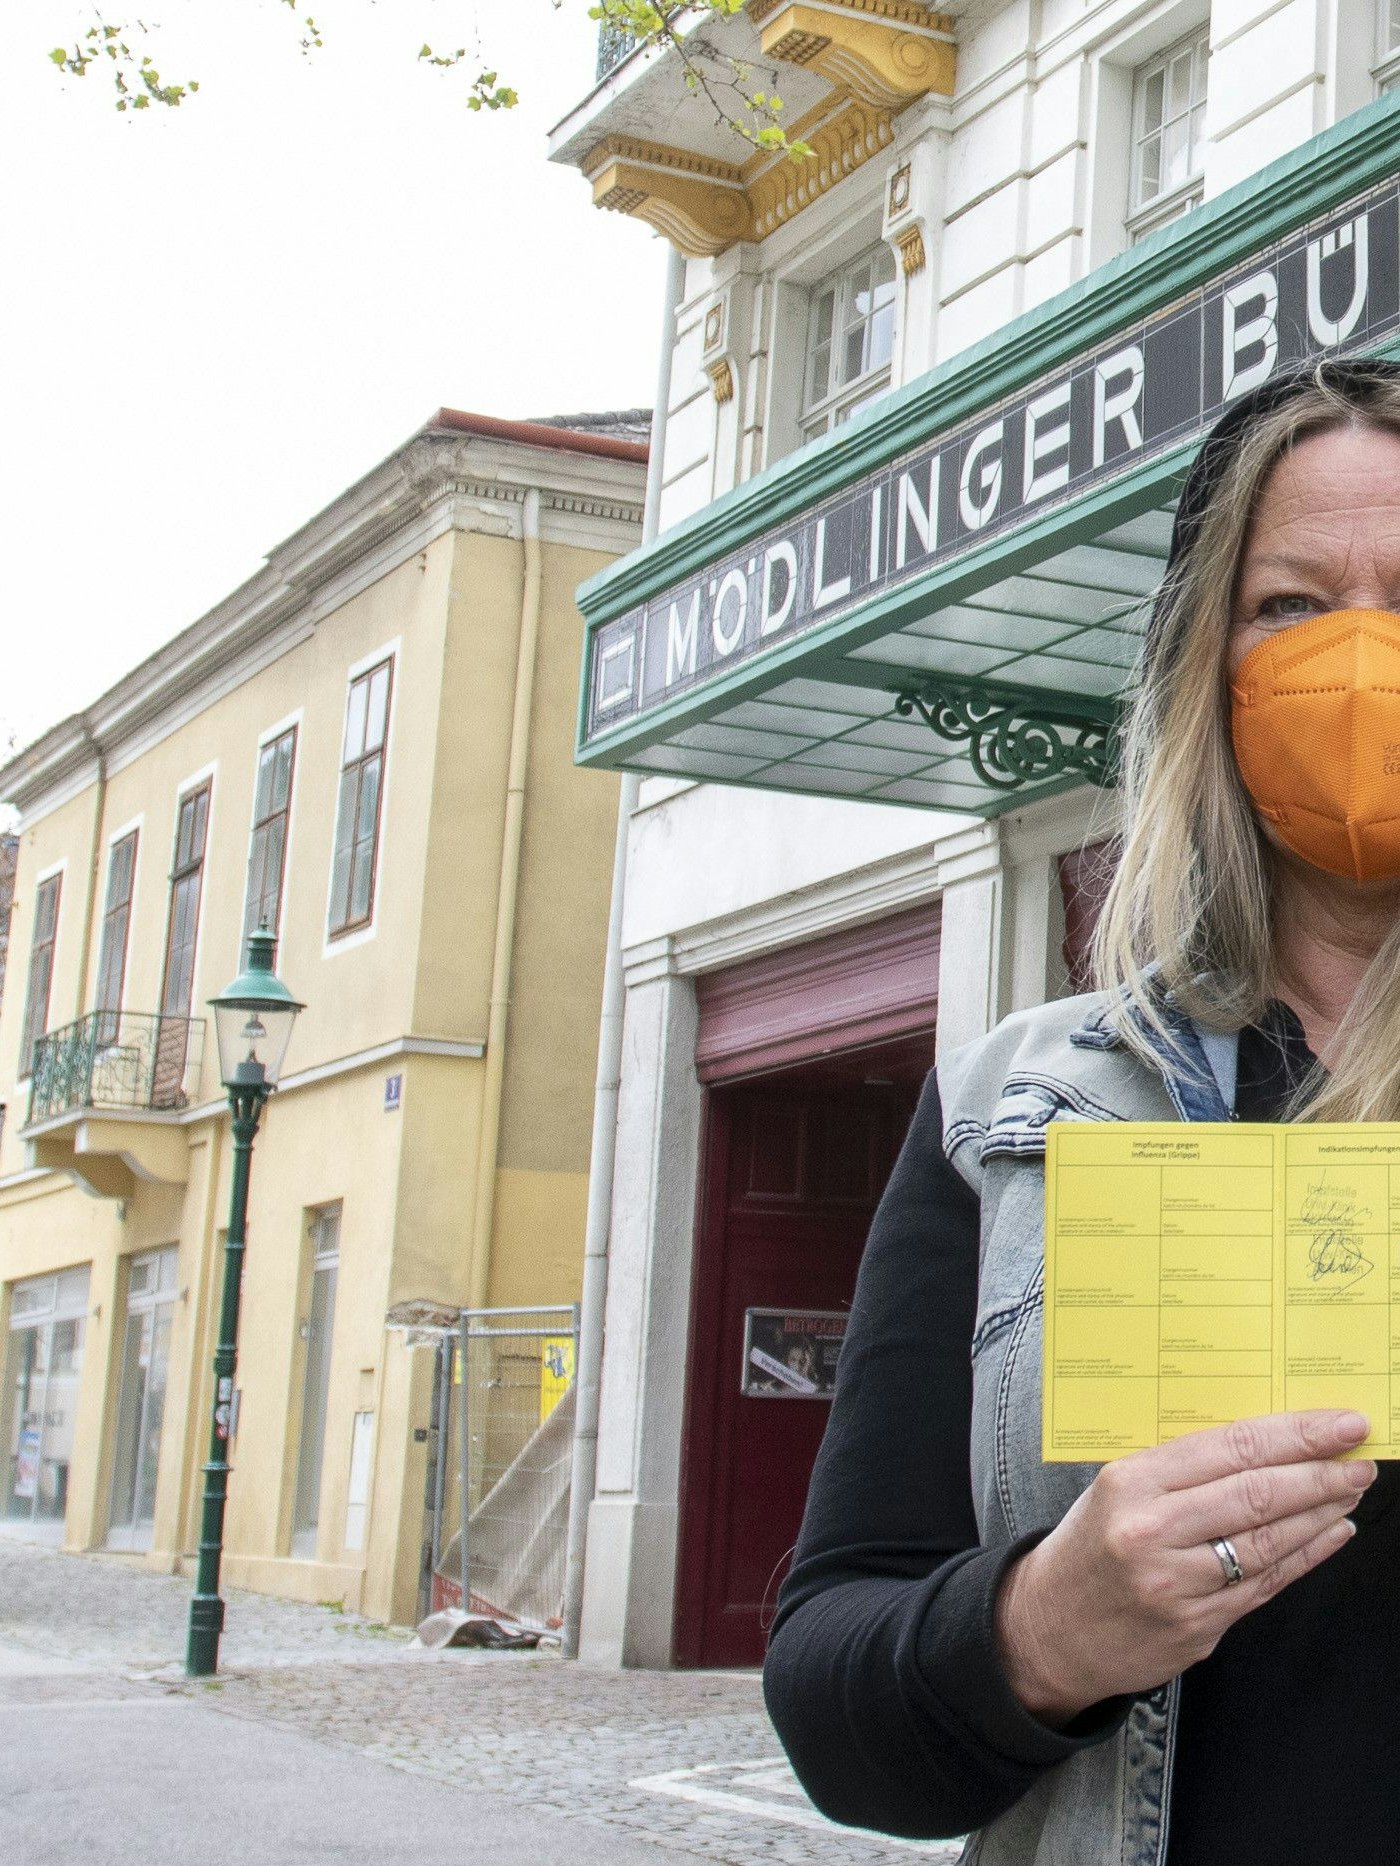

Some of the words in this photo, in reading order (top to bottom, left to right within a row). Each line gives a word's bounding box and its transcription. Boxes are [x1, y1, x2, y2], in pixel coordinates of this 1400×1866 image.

[665, 345, 1145, 688] MÖDLINGER
[1132, 1141, 1174, 1150] Impfungen
[1176, 1142, 1199, 1150] gegen
[1318, 1145, 1400, 1154] Indikationsimpfungen
[1131, 1150, 1167, 1159] Influenza
